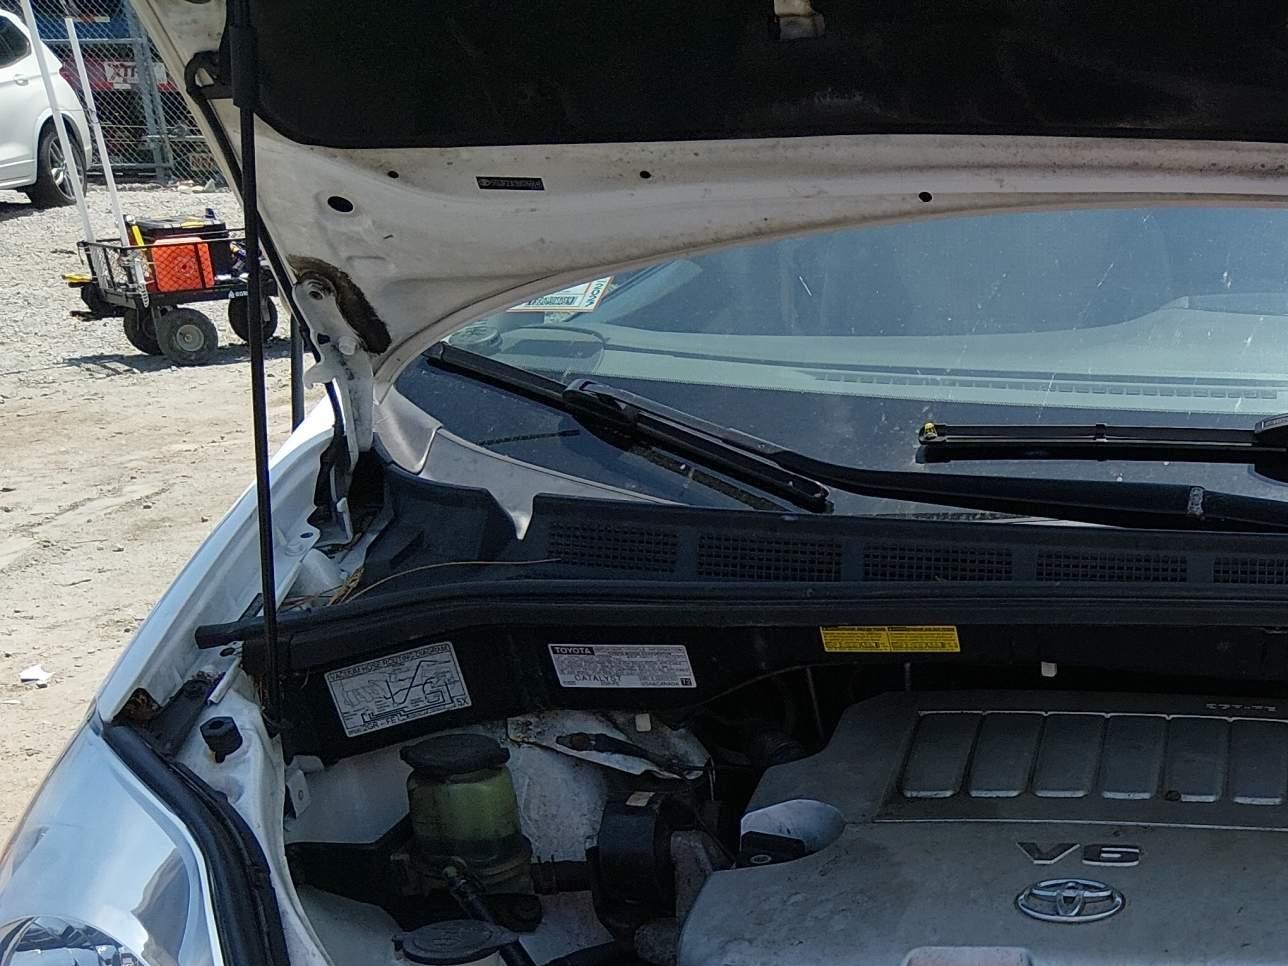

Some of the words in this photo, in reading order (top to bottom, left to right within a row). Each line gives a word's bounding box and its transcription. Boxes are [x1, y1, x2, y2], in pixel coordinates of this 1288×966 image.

[553, 646, 592, 654] TOYOTA
[574, 674, 622, 682] CATALYST
[1015, 841, 1140, 867] V6
